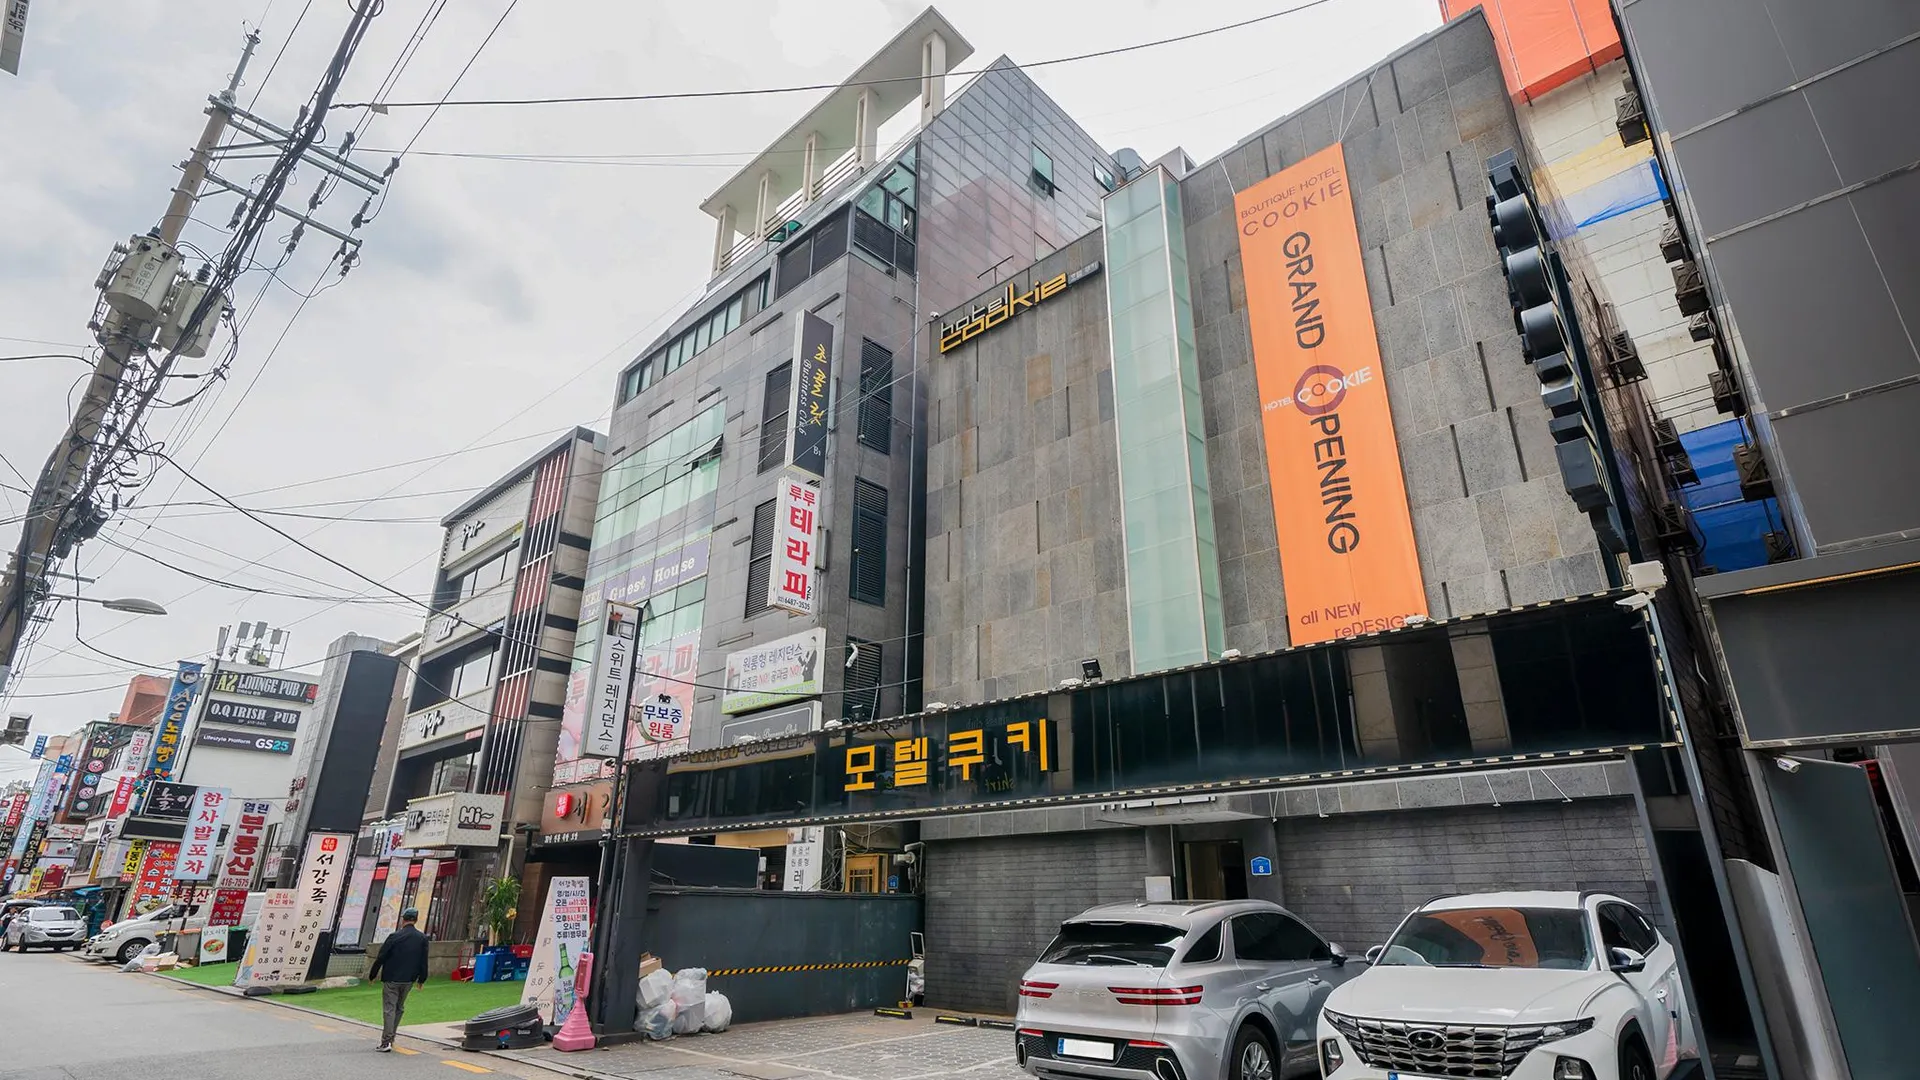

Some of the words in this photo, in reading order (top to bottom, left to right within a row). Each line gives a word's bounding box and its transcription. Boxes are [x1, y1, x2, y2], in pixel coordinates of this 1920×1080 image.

[1240, 186, 1297, 219] BOUTIQUE
[1300, 166, 1340, 191] HOTEL
[1243, 179, 1343, 236] COOKIE
[1282, 231, 1325, 350] GRAND
[940, 286, 1008, 338] hotel
[940, 272, 1068, 354] cookie
[799, 358, 812, 407] Business
[1264, 396, 1295, 412] HOTEL
[1297, 366, 1373, 404] COOKIE
[789, 484, 815, 507] 루루
[783, 506, 813, 600] 테라피
[609, 575, 646, 602] Guest
[653, 556, 695, 584] House
[1300, 610, 1318, 625] all
[1325, 602, 1362, 621] NEW
[1334, 612, 1418, 638] reDESIG
[606, 639, 626, 681] 스위트
[769, 643, 803, 663] 레지던스
[238, 675, 279, 693] LOUNGE
[278, 680, 300, 697] PUB
[210, 703, 231, 718] O.Q
[232, 706, 267, 721] IRISH
[272, 711, 297, 724] PUB
[598, 684, 620, 742] 레지던스
[643, 705, 682, 724] 무보증
[649, 722, 674, 739] 원룸
[92, 747, 110, 758] VIP
[156, 721, 179, 762] 노래방
[255, 738, 289, 752] GS25
[244, 802, 270, 815] 열린
[226, 815, 265, 877] 부동산
[221, 877, 250, 888] 416-7575
